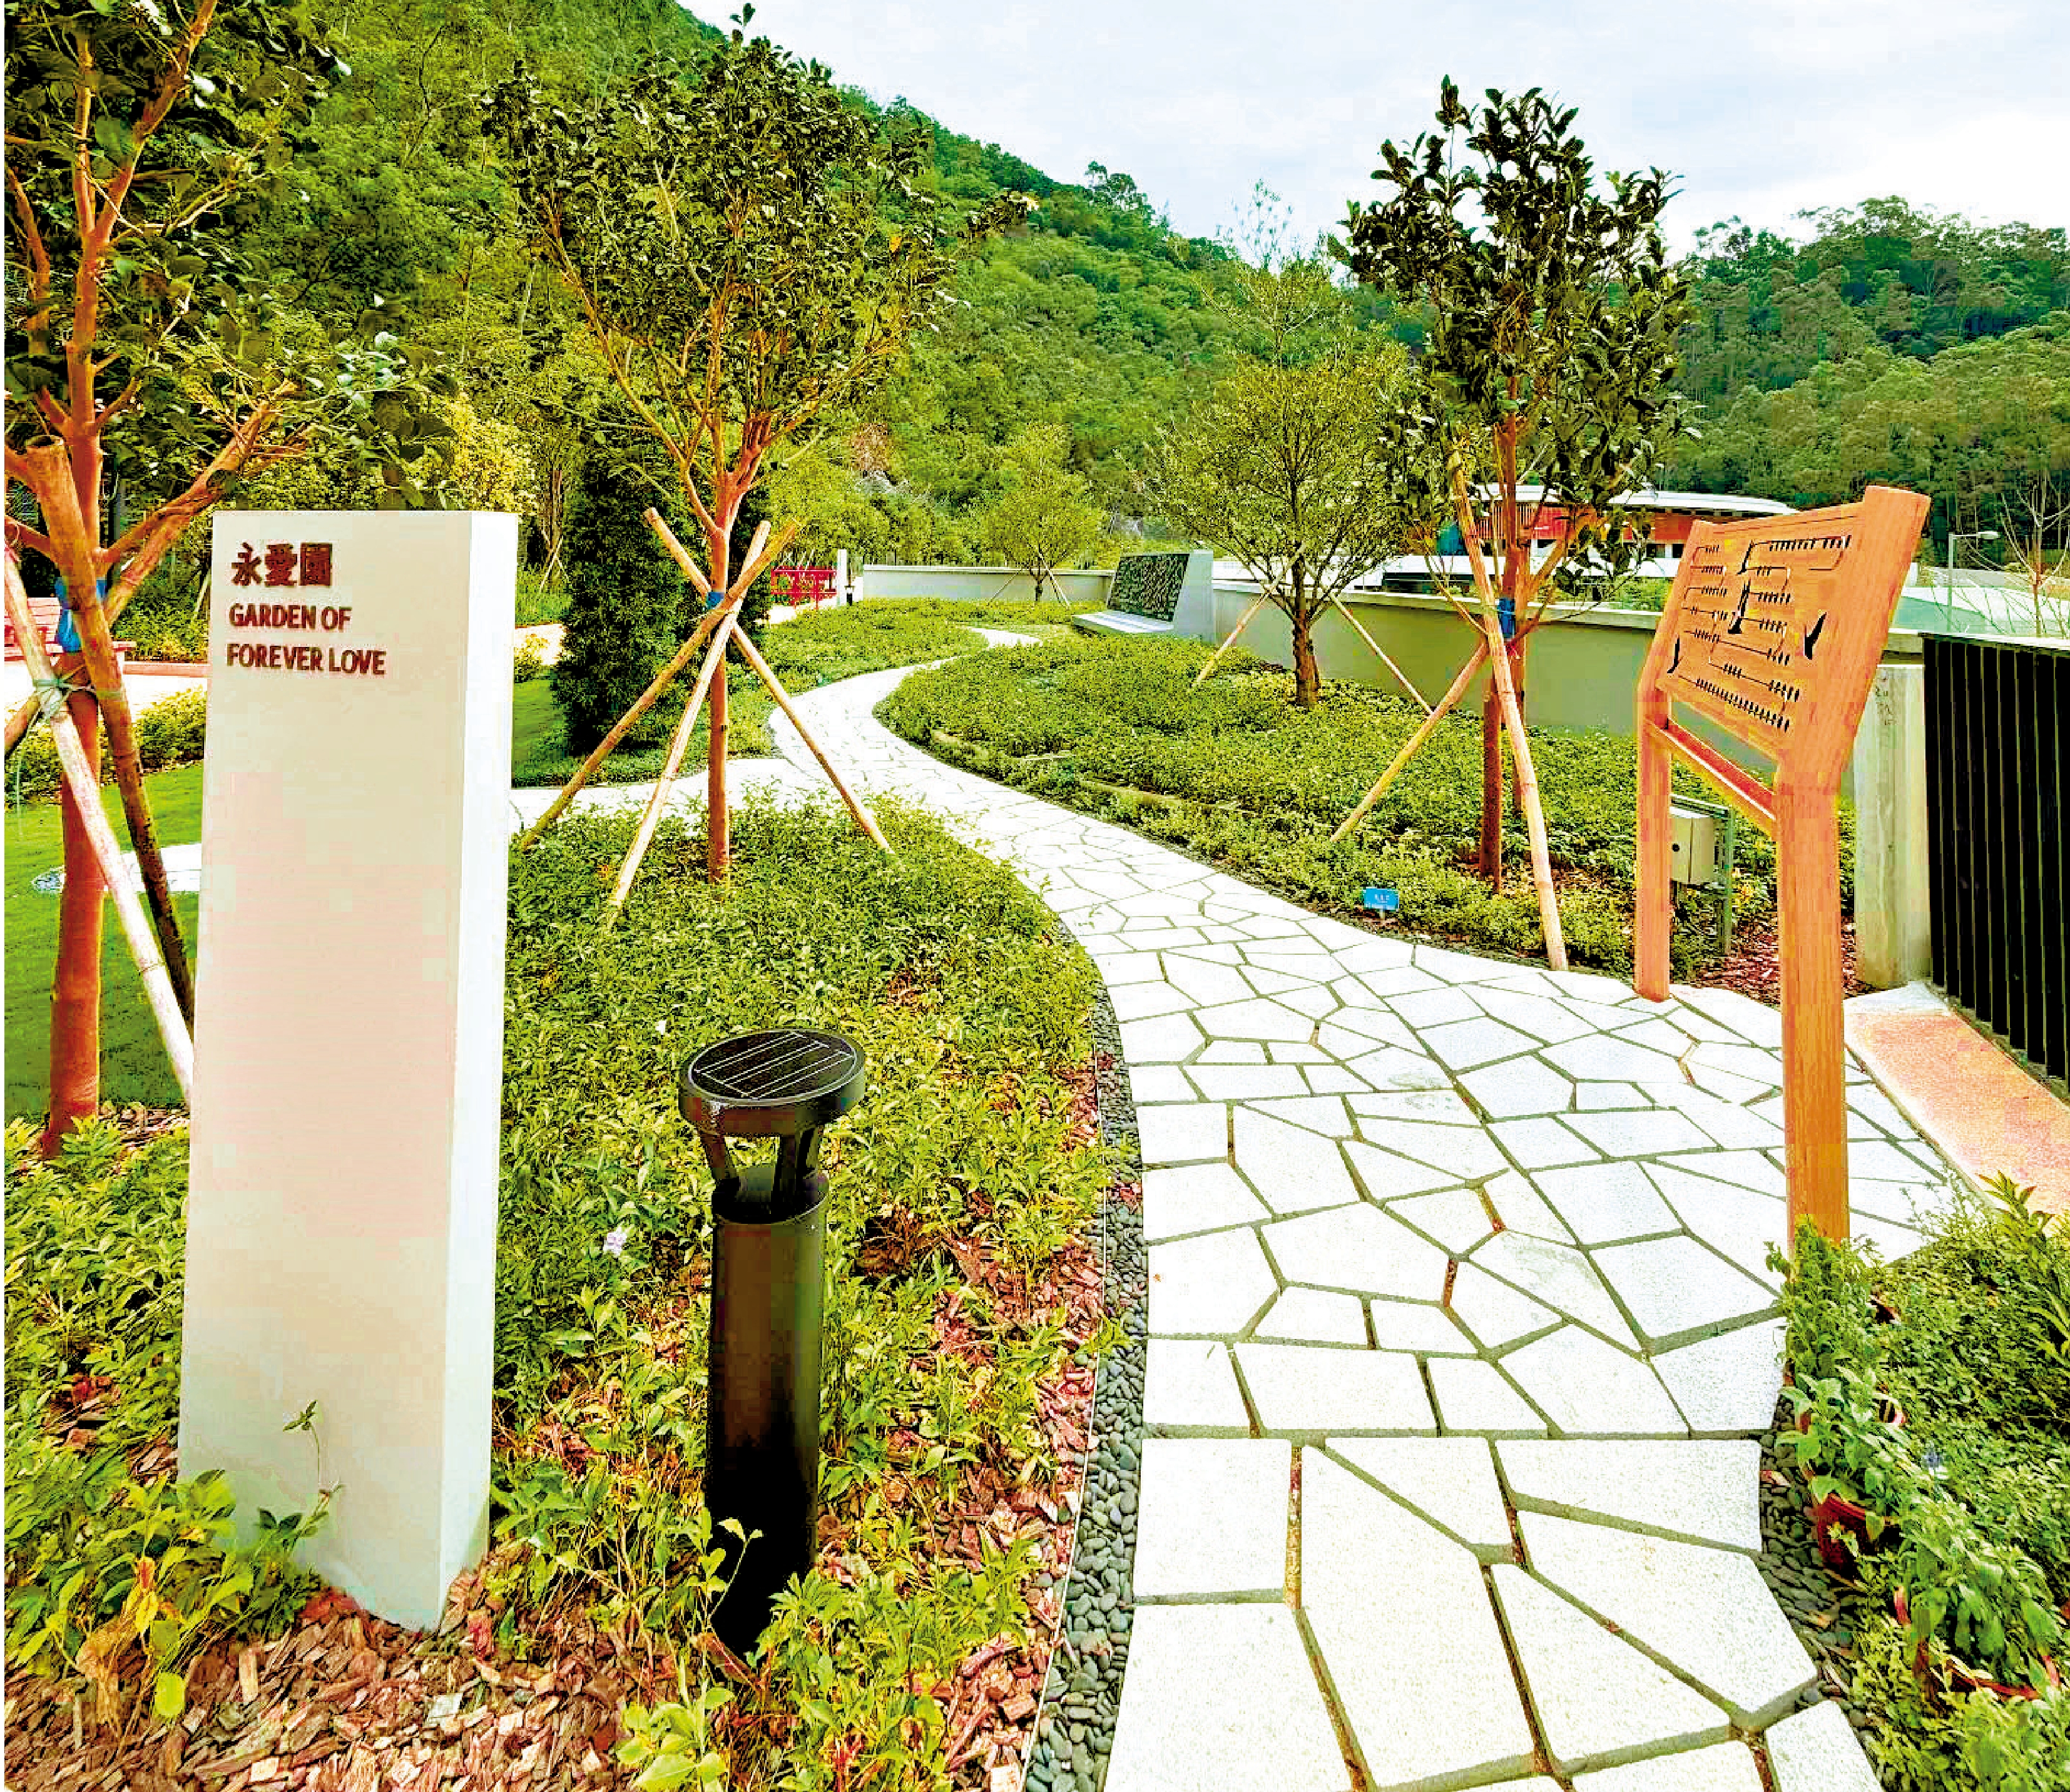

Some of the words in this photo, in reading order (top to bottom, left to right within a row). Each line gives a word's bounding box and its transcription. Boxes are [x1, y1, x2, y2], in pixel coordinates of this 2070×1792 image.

[229, 603, 316, 629] GARDEN
[321, 606, 352, 631] OF
[227, 643, 324, 672] FOREVER
[329, 648, 387, 675] LOVE
